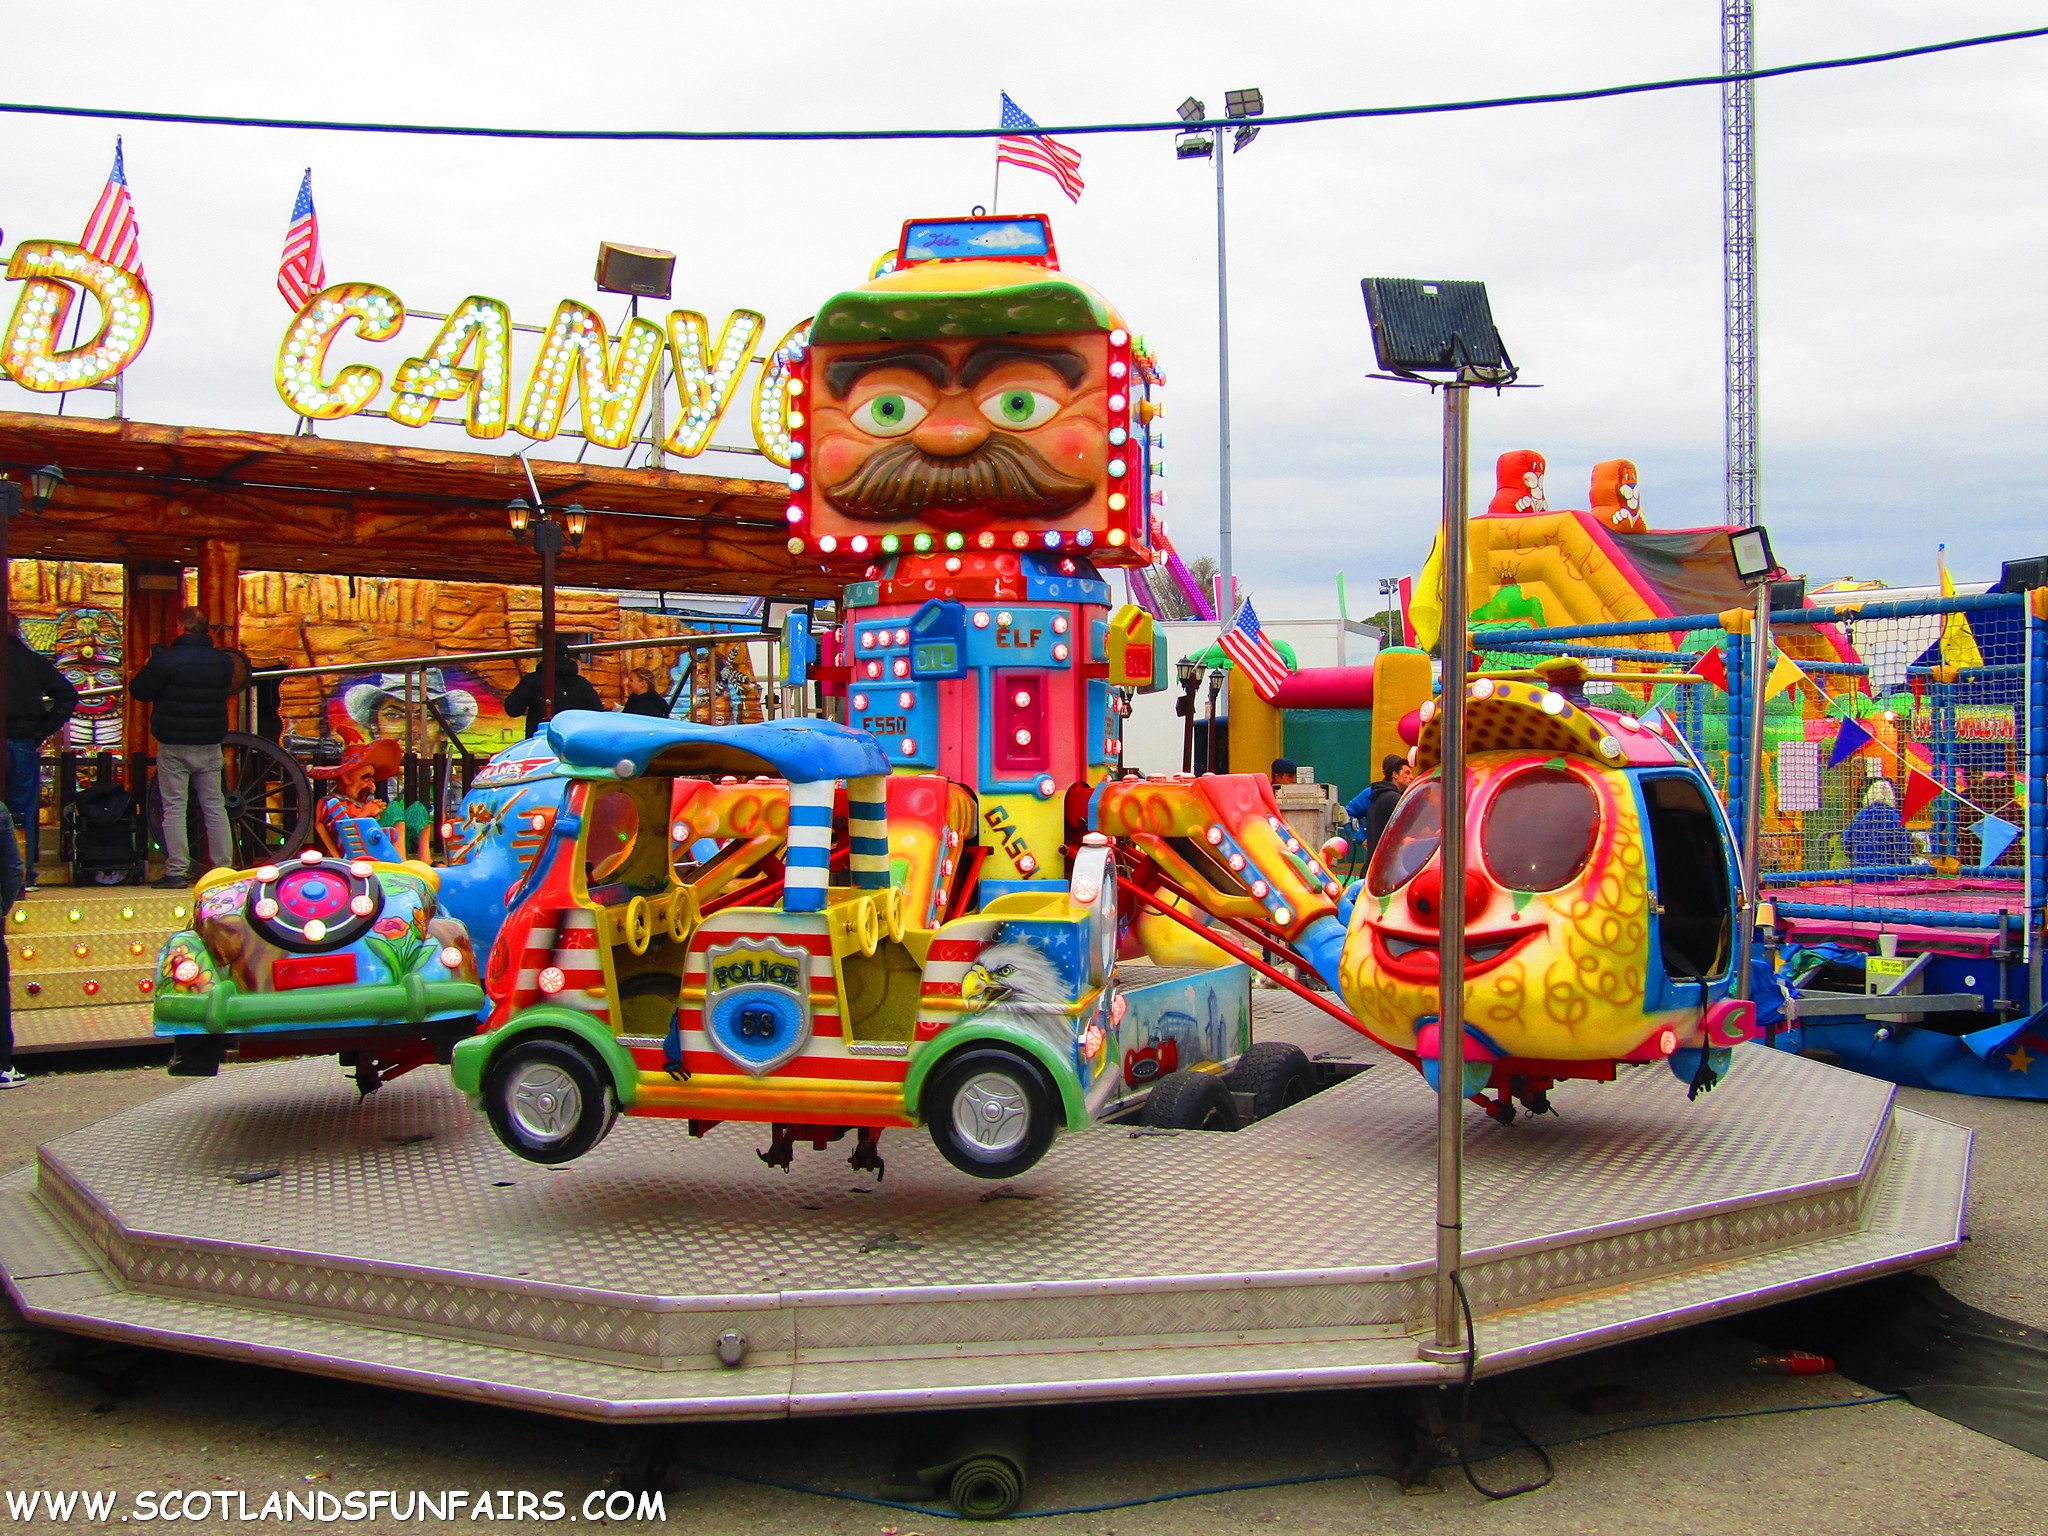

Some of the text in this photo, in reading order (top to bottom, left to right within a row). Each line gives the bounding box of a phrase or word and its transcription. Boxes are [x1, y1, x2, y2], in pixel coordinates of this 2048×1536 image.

[996, 625, 1043, 648] ELF
[917, 647, 953, 668] OIL
[479, 763, 523, 780] PLANES
[714, 960, 800, 989] POLICE
[1880, 960, 1902, 969] Danger
